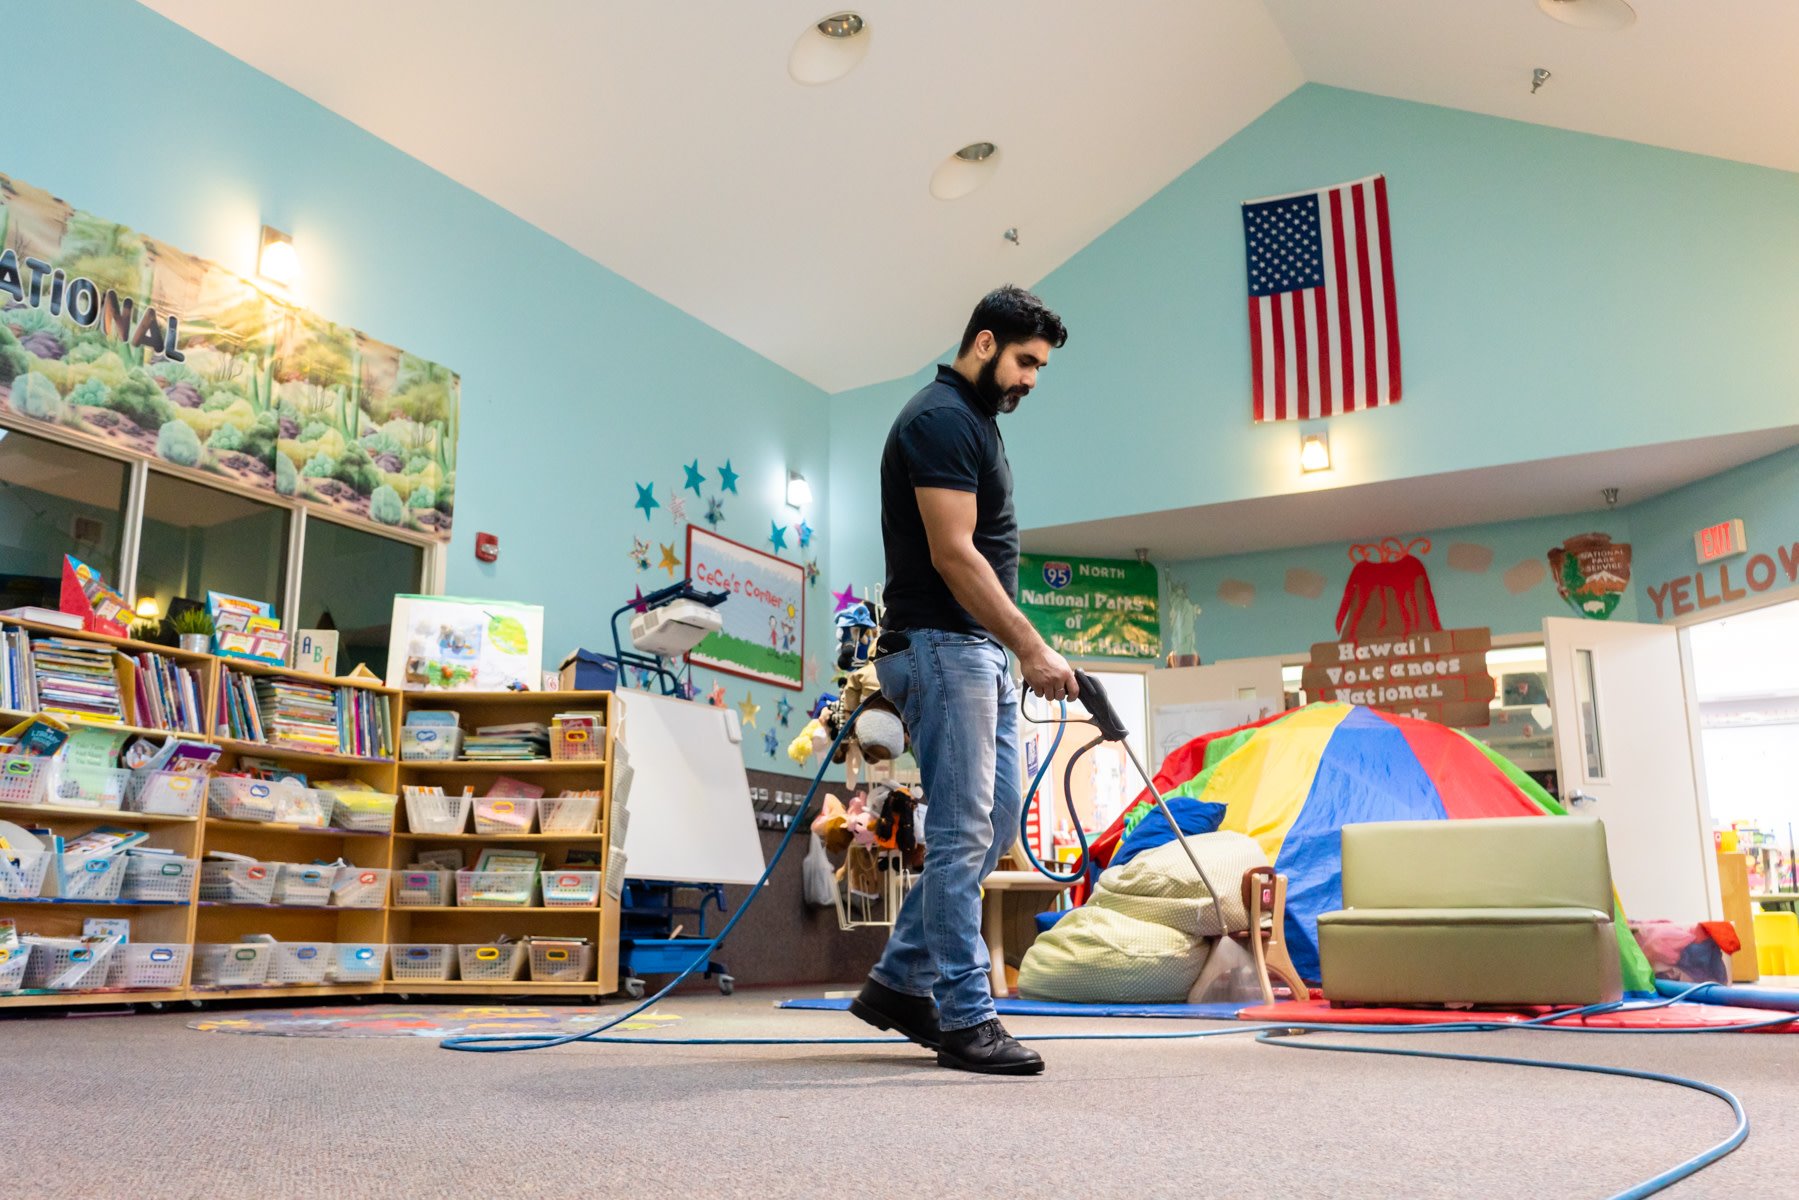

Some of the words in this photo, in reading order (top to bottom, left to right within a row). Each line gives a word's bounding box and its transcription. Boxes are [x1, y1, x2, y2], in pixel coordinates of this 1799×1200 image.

[1701, 522, 1732, 559] EXIT
[1047, 568, 1067, 585] 95
[1079, 564, 1125, 579] NORTH
[696, 563, 740, 593] CeCe's
[744, 579, 783, 608] Corner
[1022, 589, 1089, 608] National
[1094, 592, 1144, 612] Parks
[1065, 614, 1083, 629] of
[302, 635, 311, 654] A
[313, 646, 322, 663] B
[1051, 635, 1092, 654] York
